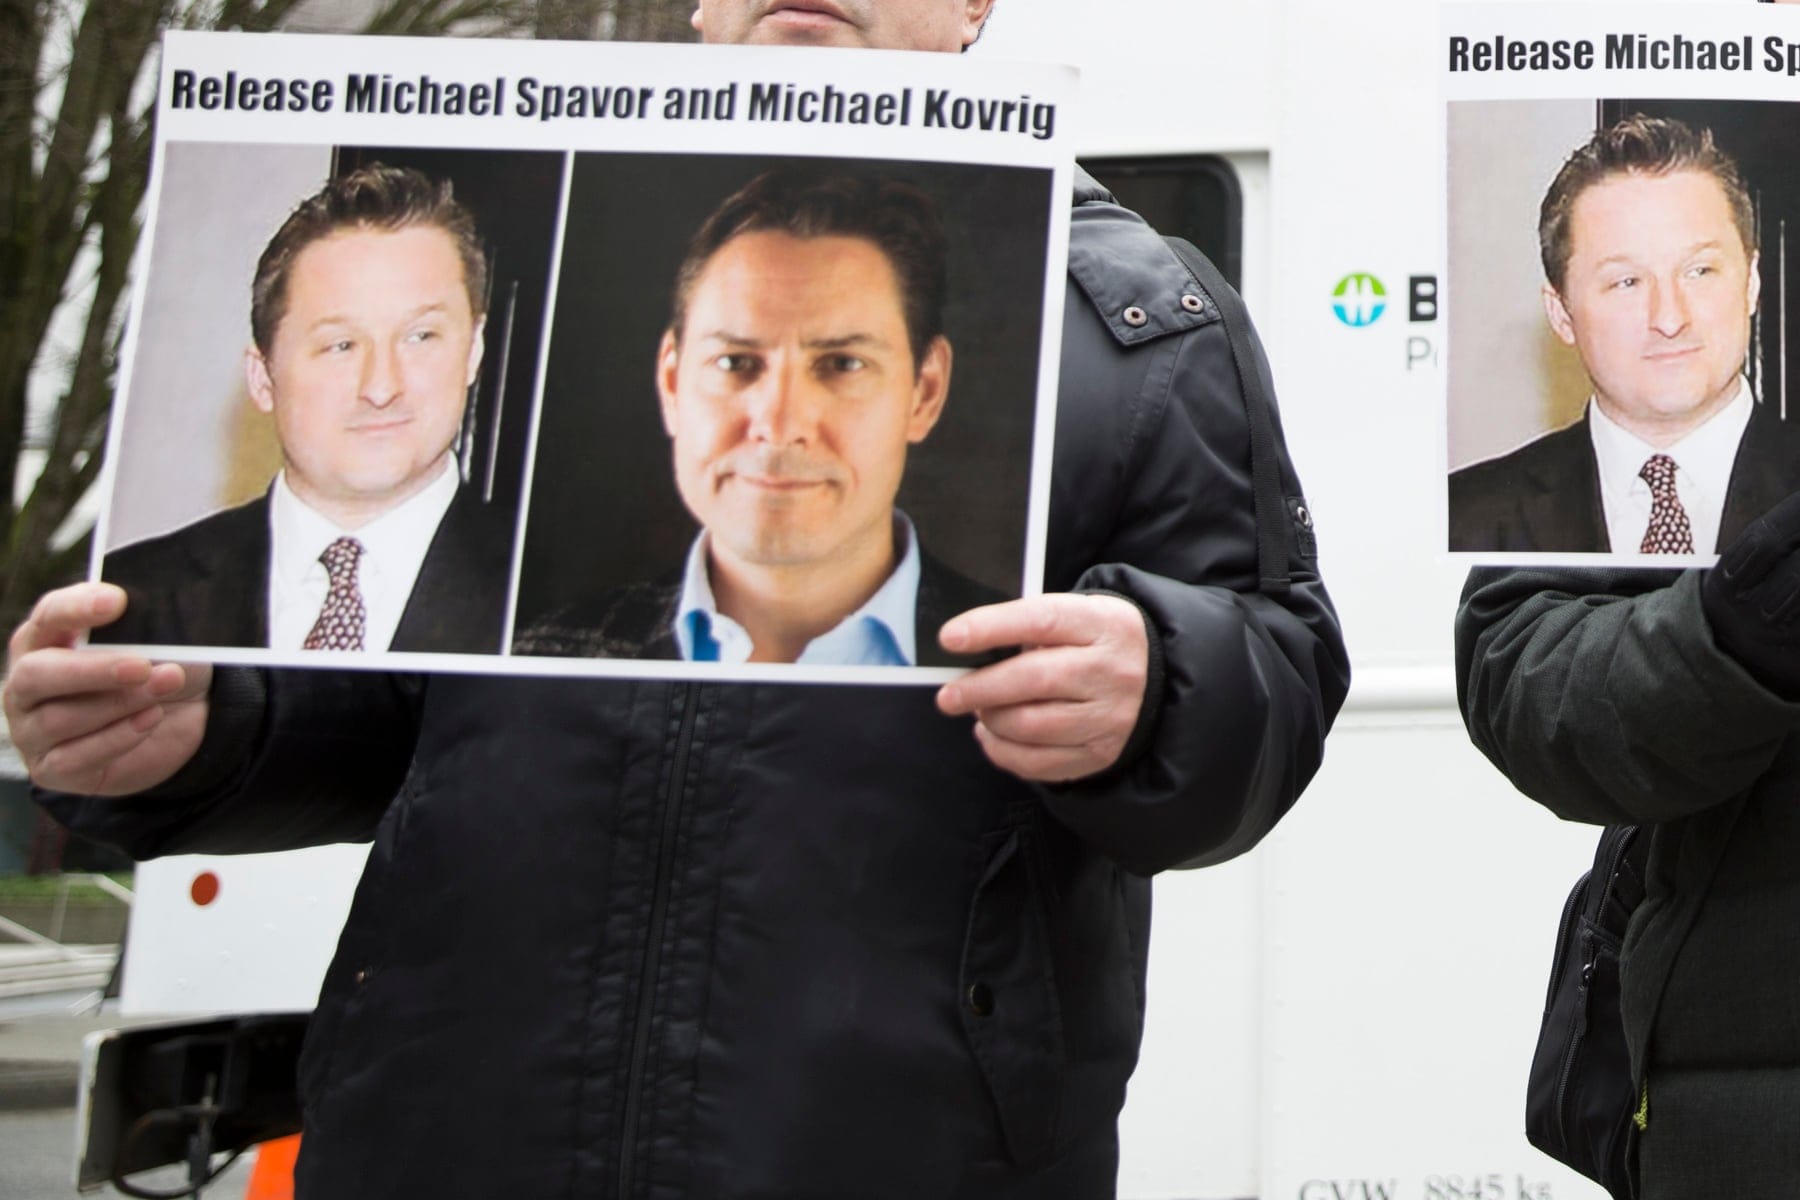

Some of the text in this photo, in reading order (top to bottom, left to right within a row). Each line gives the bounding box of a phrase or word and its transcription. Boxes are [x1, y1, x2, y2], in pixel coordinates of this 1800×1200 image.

[1449, 35, 1594, 73] Release
[1605, 33, 1752, 71] Michael
[171, 69, 1056, 140] Release Michael Spavor and Michael Kovrig
